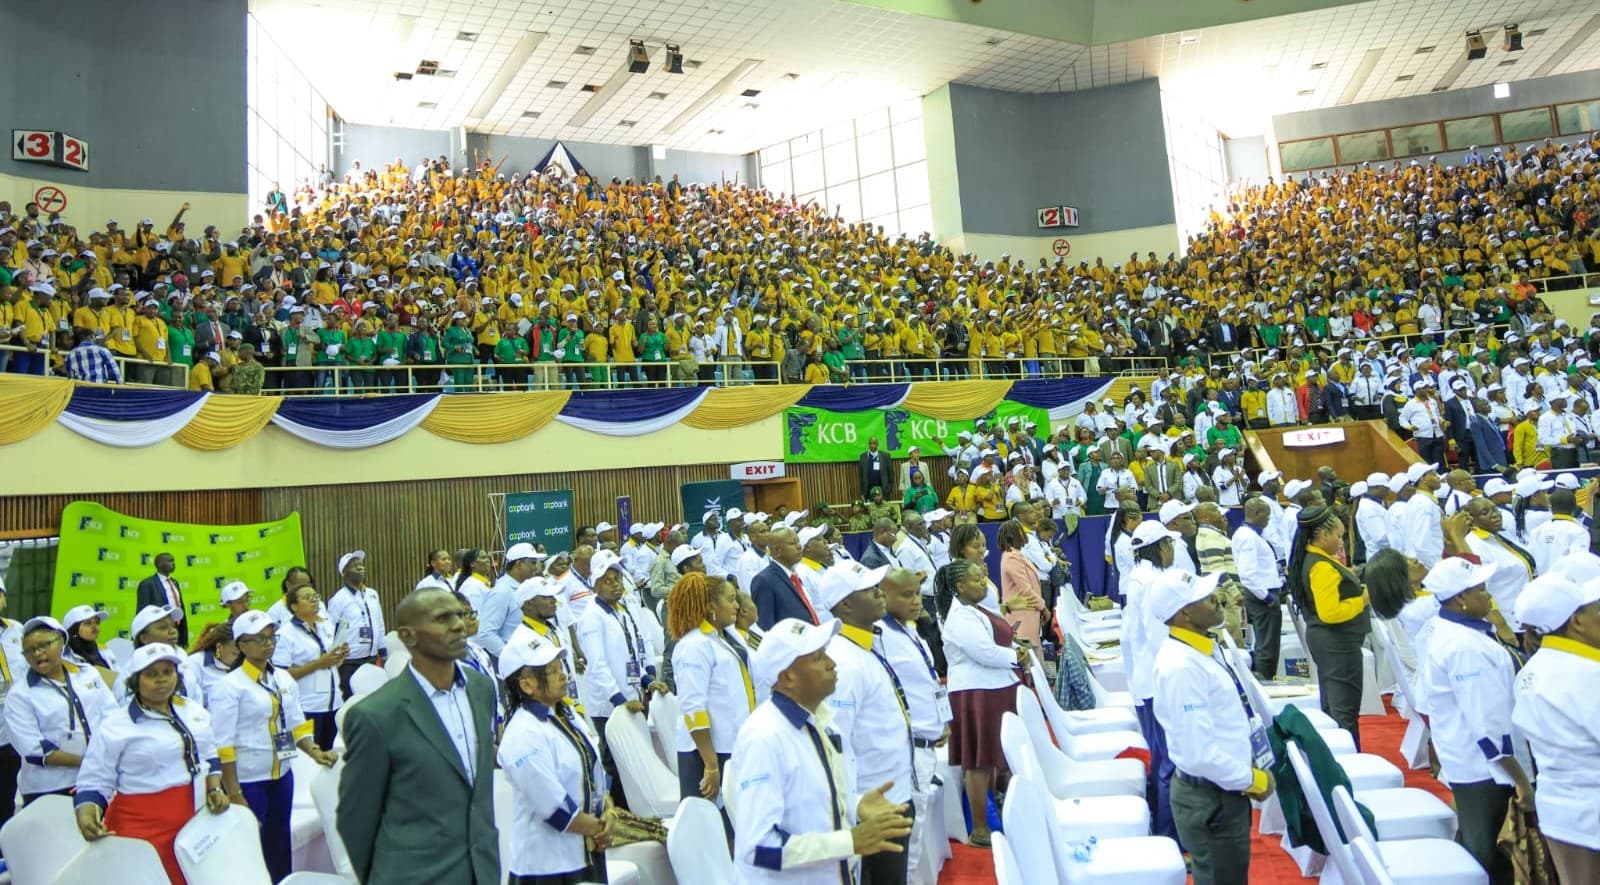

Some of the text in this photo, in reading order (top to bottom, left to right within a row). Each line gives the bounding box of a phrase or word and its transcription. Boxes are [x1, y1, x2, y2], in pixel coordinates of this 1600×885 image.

[27, 132, 50, 157] 3
[65, 139, 81, 165] 2
[1044, 209, 1058, 225] 2
[1065, 209, 1073, 225] 1
[817, 422, 857, 445] KCB
[911, 418, 948, 440] KCB
[1297, 431, 1330, 441] EXIT
[745, 464, 775, 475] EXIT
